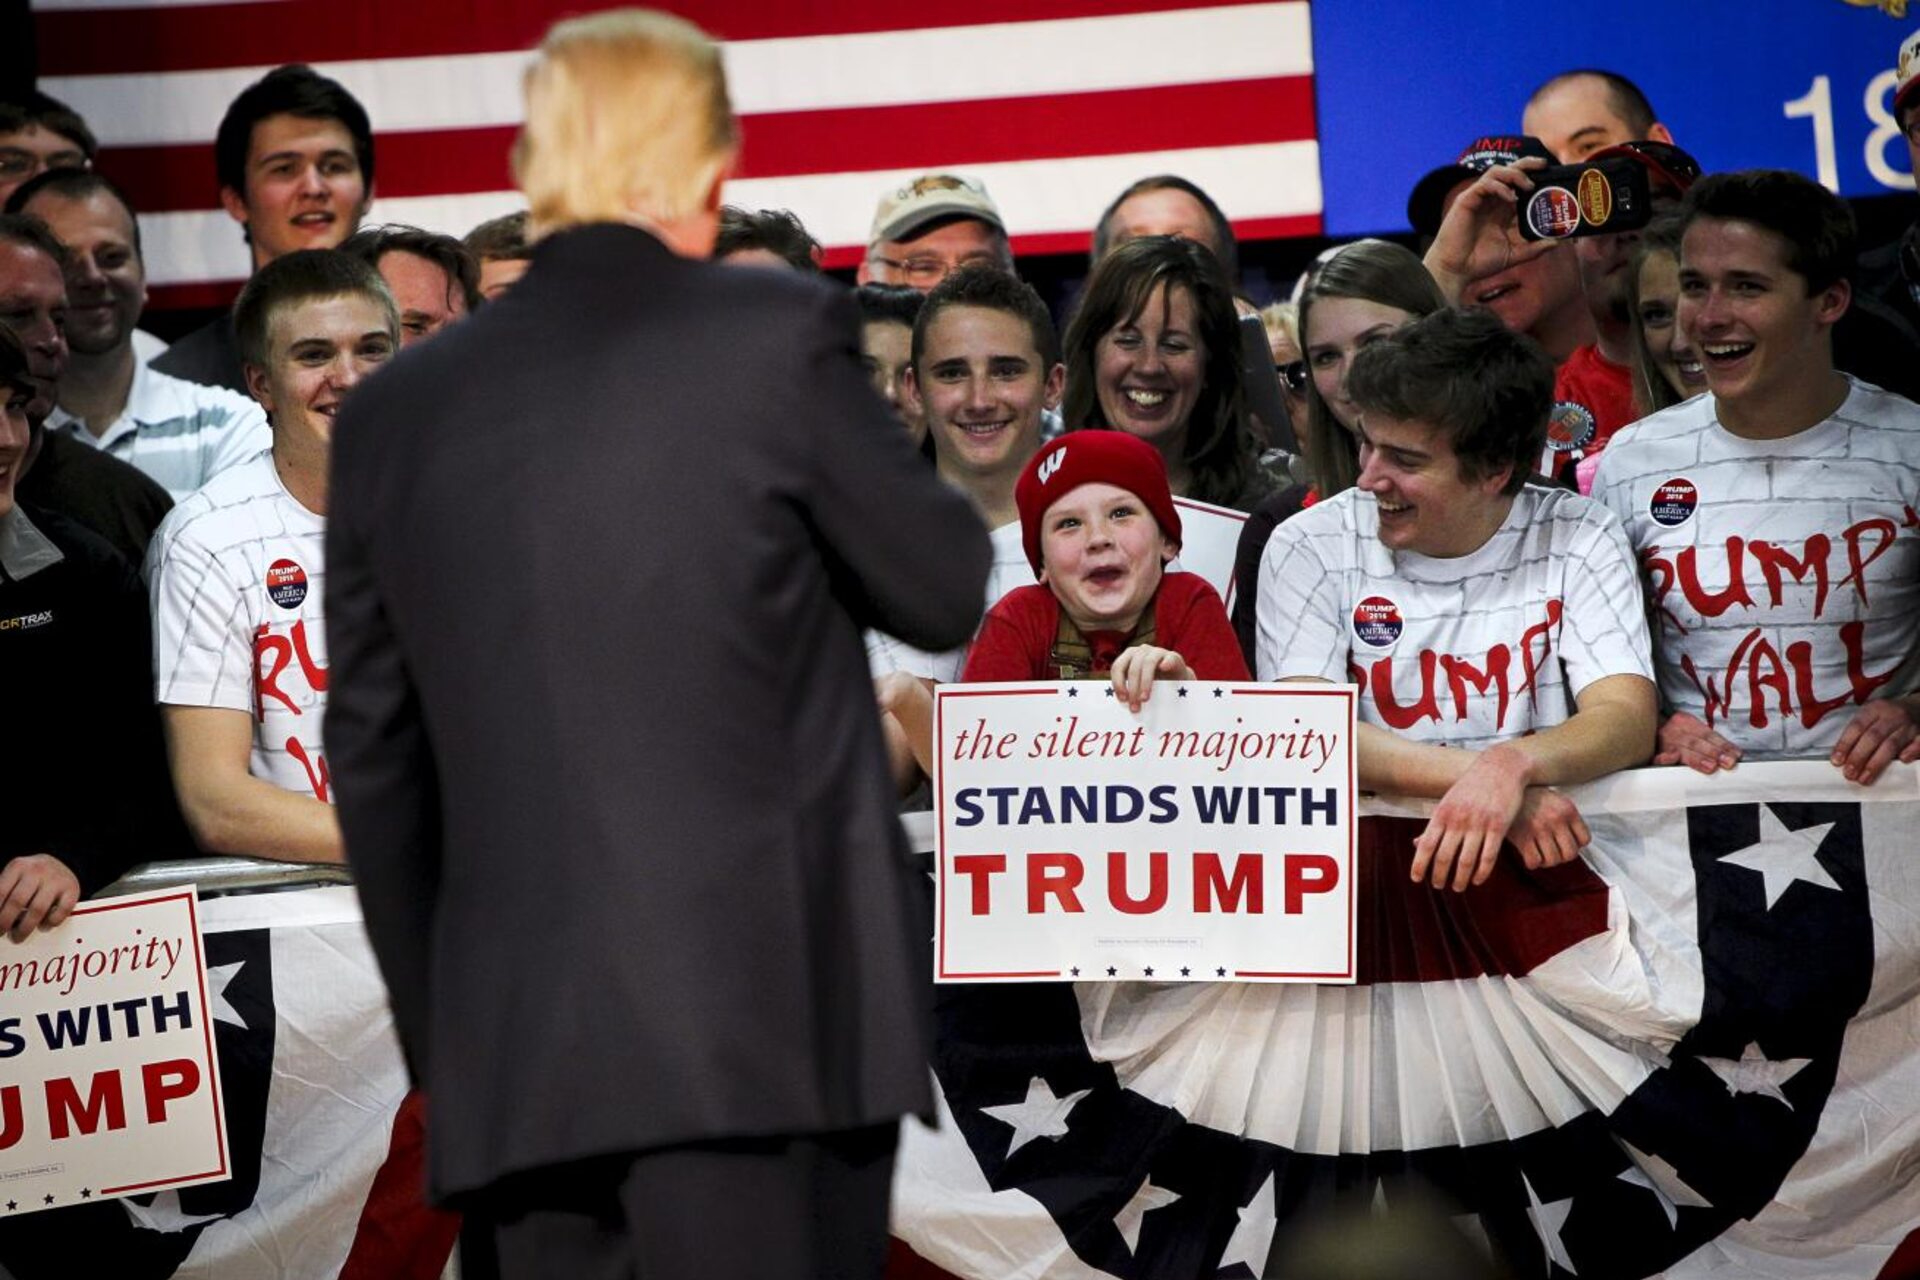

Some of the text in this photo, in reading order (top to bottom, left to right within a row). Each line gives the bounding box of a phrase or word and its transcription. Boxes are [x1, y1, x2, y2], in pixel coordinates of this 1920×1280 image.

[1038, 446, 1067, 485] W
[1660, 485, 1694, 494] TRUMP
[1666, 492, 1684, 500] 2016
[270, 565, 300, 576] TRUMP
[278, 574, 294, 583] 2016
[1360, 604, 1397, 613] TRUMP
[1369, 612, 1387, 620] 2016
[1681, 620, 1906, 730] WALL
[953, 716, 1337, 774] the silent majority
[954, 785, 1338, 827] STANDS WITH
[953, 852, 1340, 916] TRUMP
[36, 991, 193, 1050] WITH
